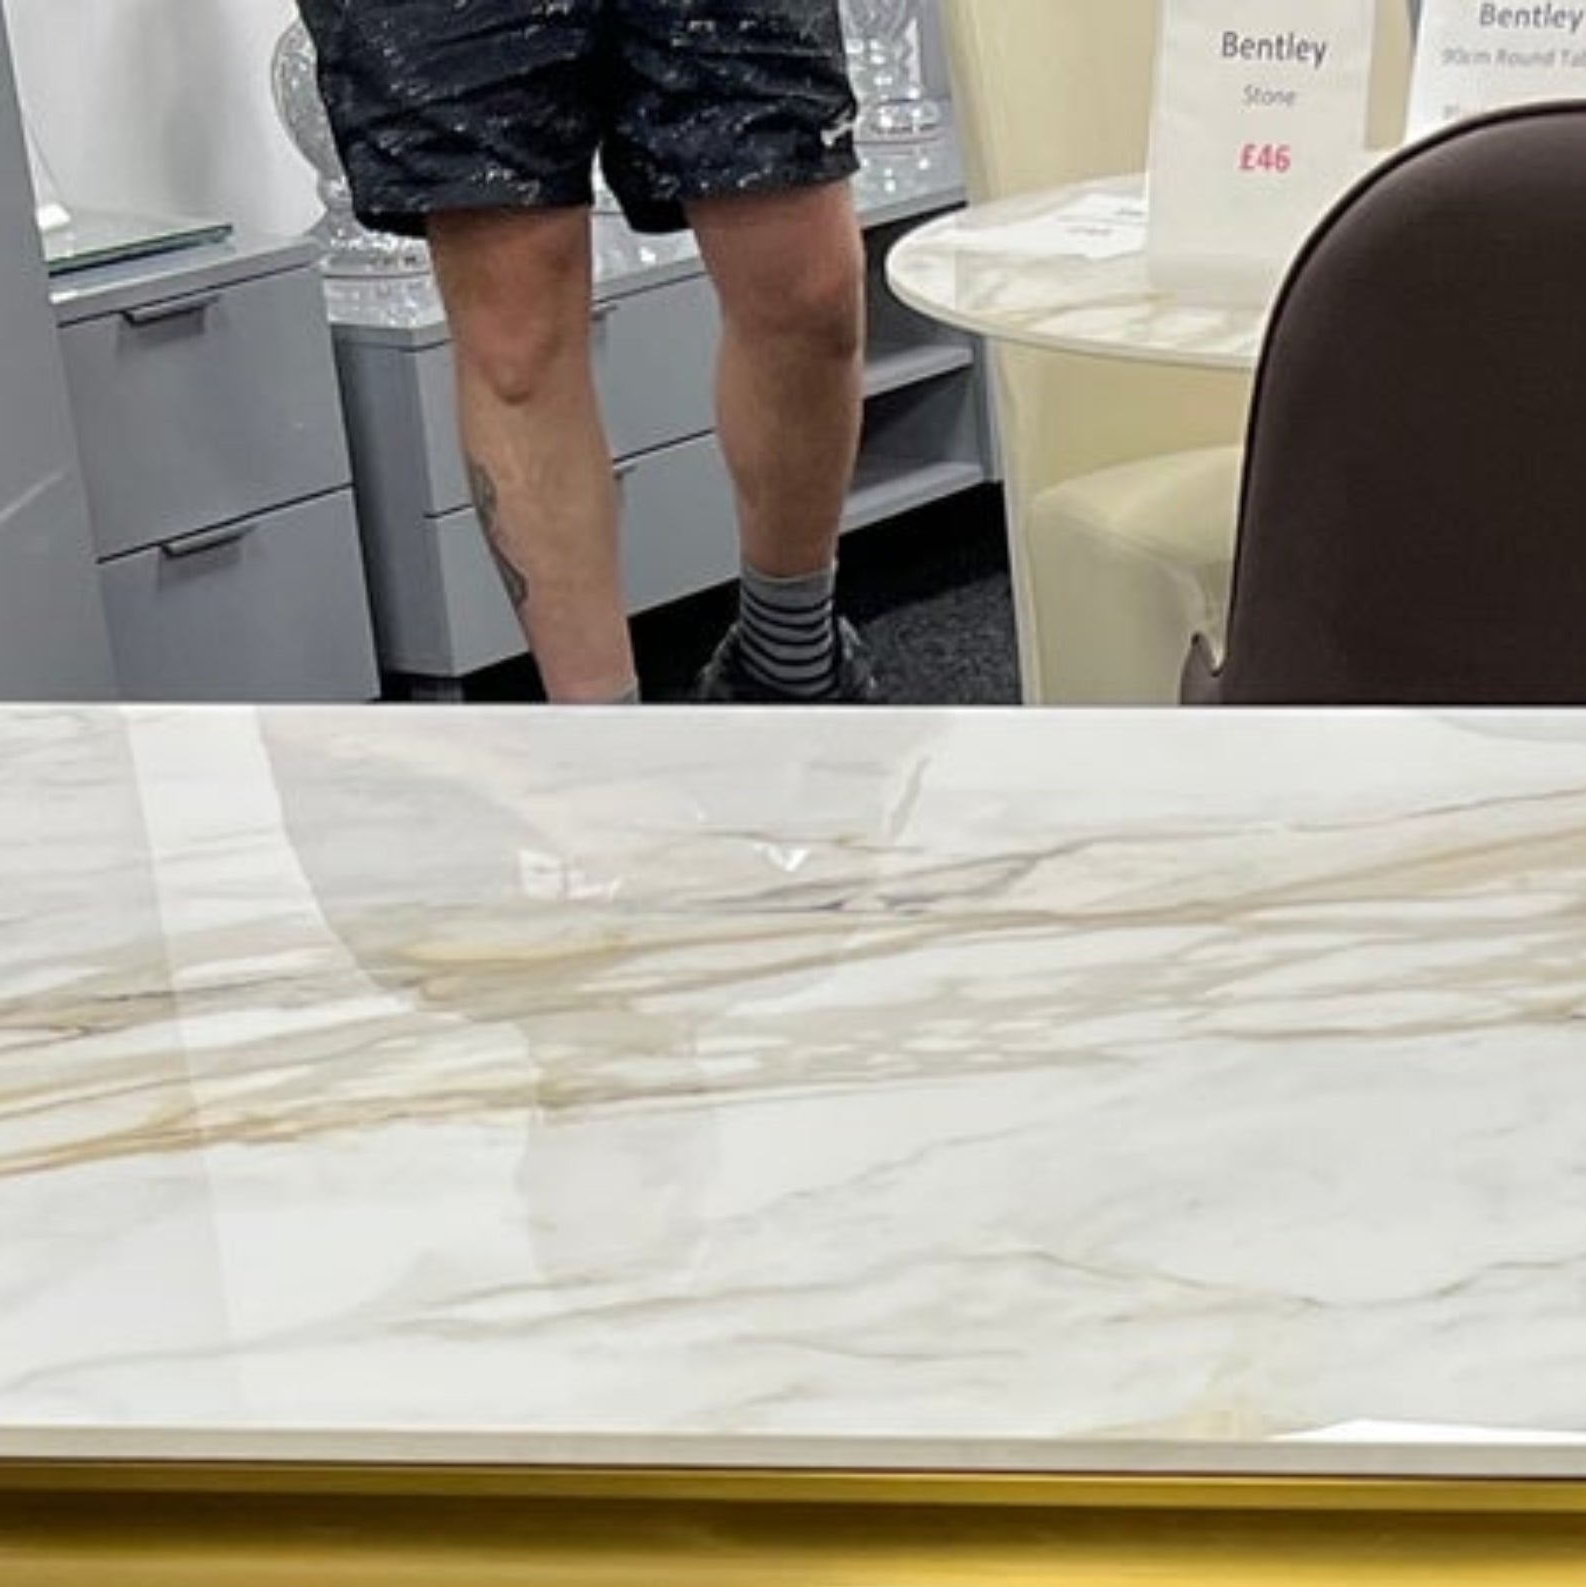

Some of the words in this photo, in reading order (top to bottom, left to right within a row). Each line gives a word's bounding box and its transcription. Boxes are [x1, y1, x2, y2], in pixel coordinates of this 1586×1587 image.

[1479, 2, 1584, 34] Bentley
[1221, 30, 1328, 71] Bentley
[1238, 142, 1291, 173] £46
